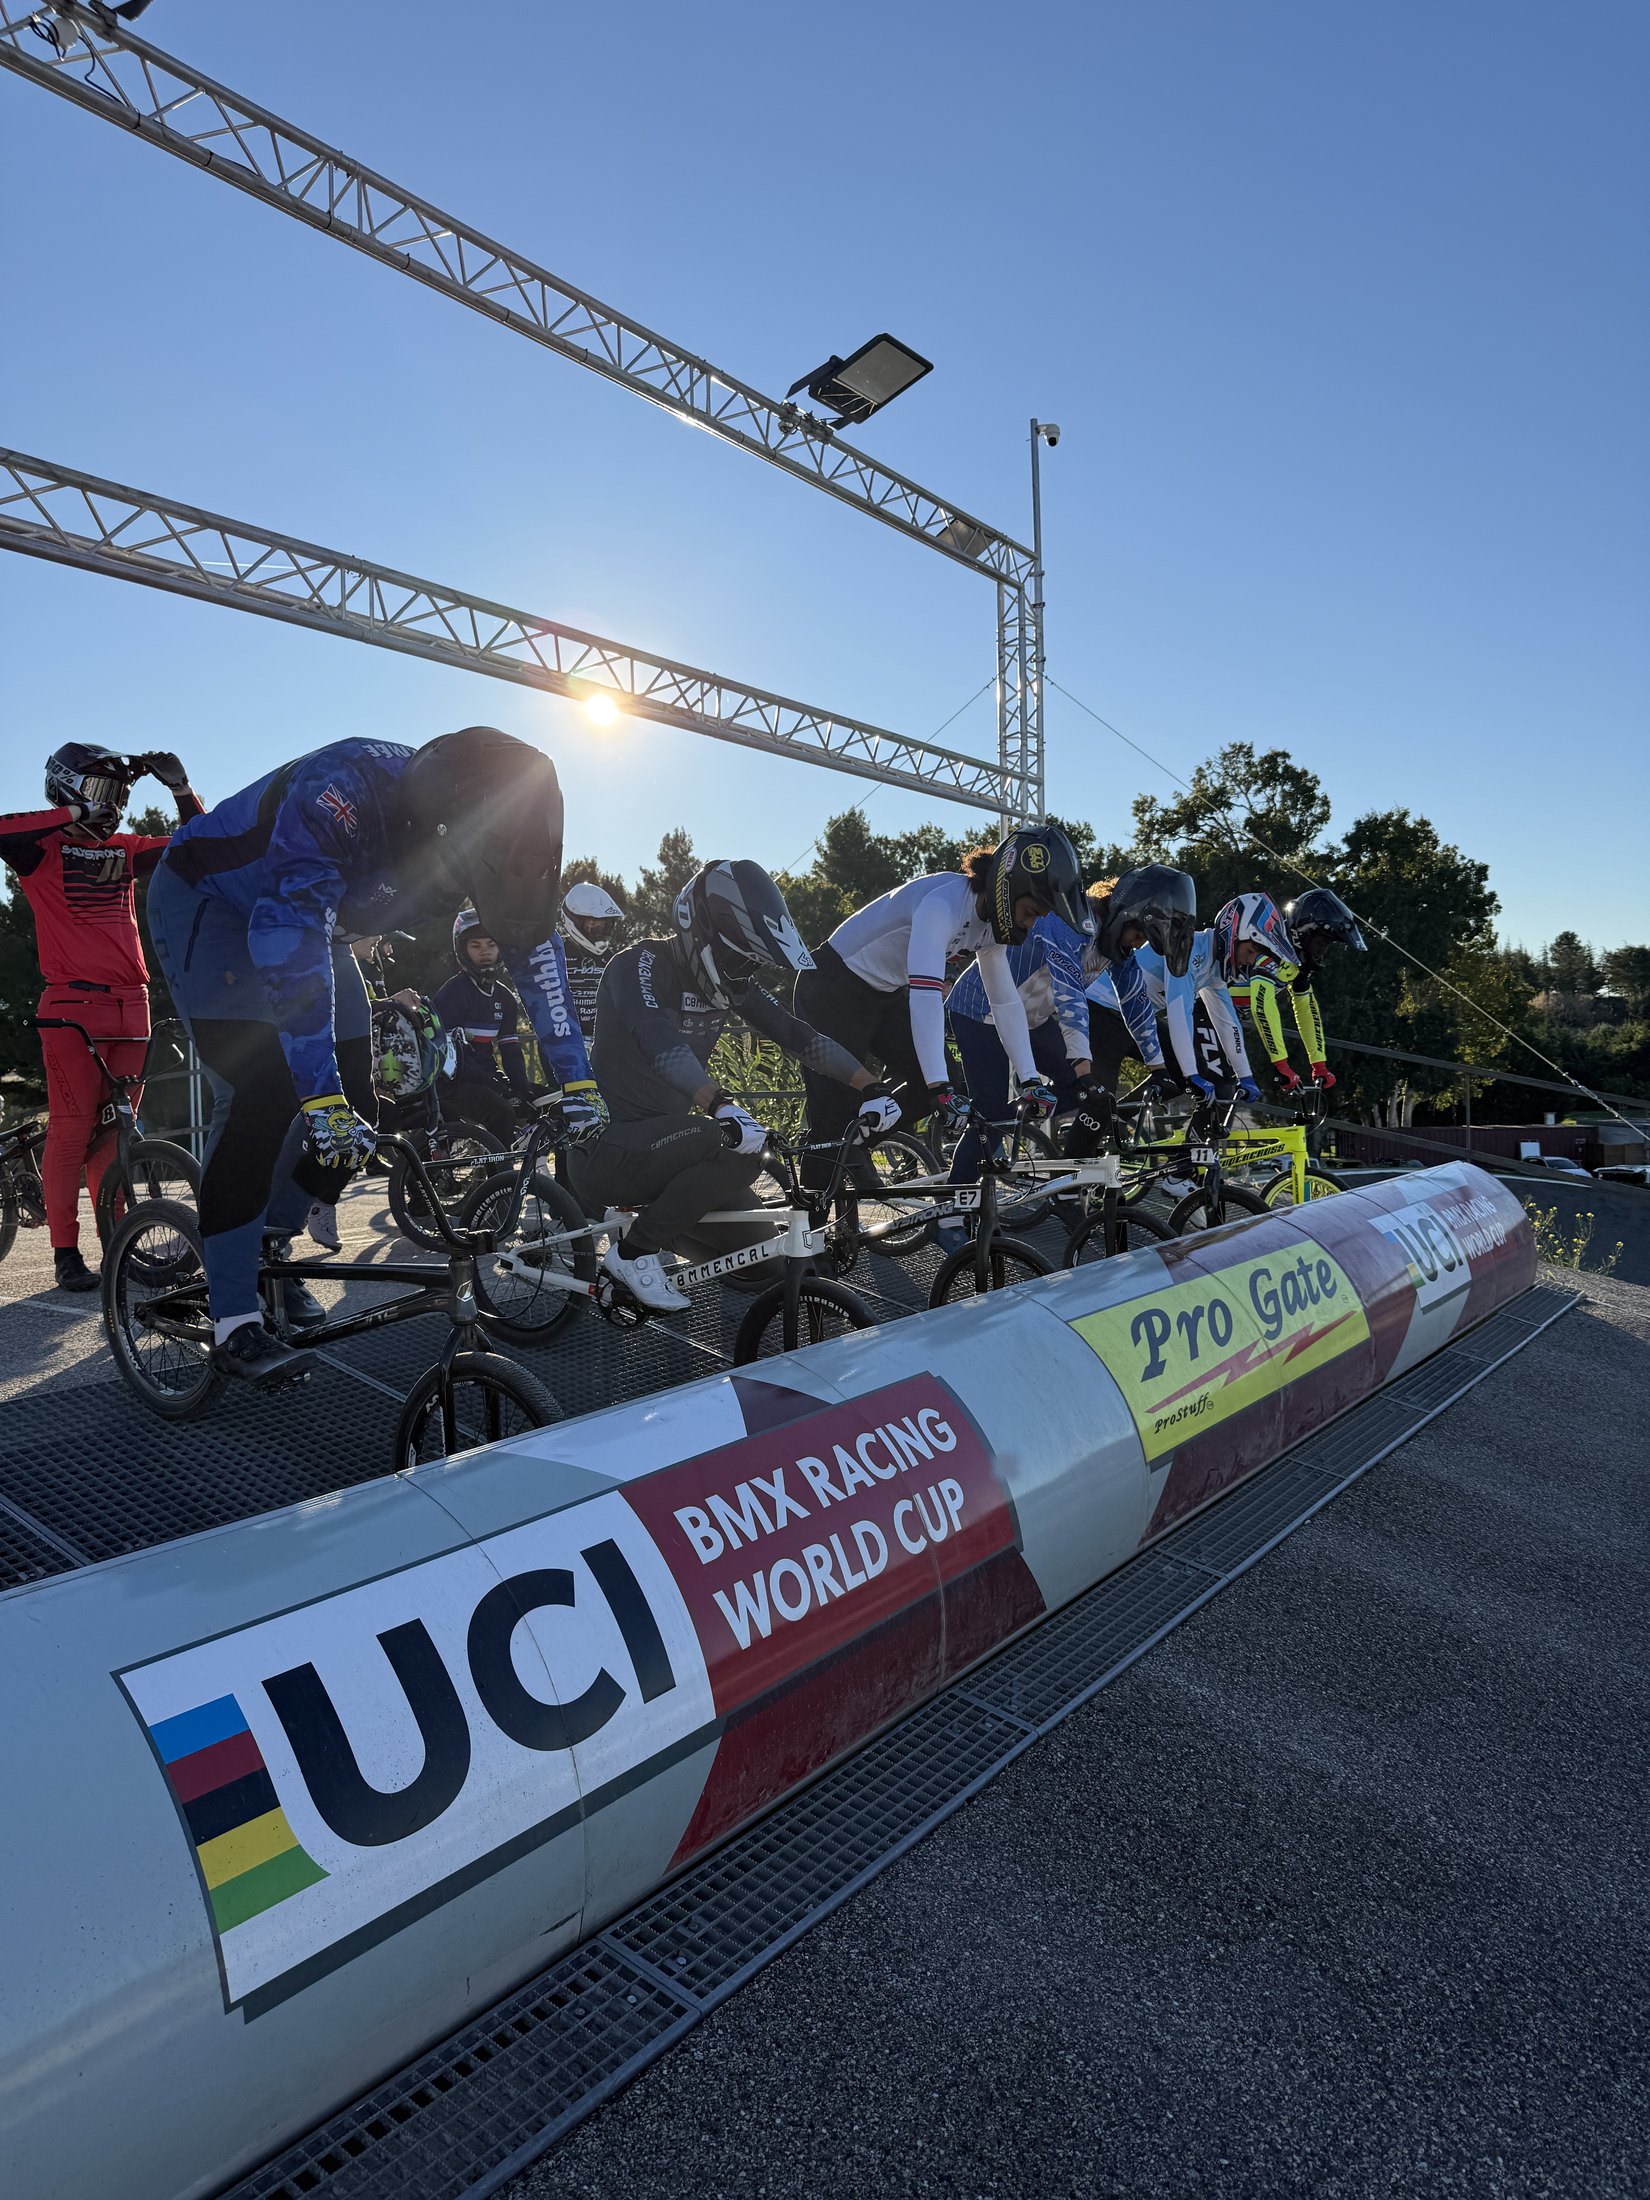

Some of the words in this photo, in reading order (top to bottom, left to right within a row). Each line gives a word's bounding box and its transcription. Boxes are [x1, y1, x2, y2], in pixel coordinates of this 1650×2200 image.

[566, 966, 605, 975] CHAS
[1196, 1027, 1224, 1078] FLY
[1232, 1026, 1242, 1054] PENKS
[959, 1190, 977, 1206] E7
[1393, 1214, 1463, 1282] UCI
[1462, 1227, 1492, 1260] WORLD
[1489, 1222, 1507, 1248] CUP
[676, 1245, 770, 1287] OMMENCAL
[1130, 1298, 1233, 1383] Pro
[1249, 1256, 1338, 1341] Gate
[1154, 1392, 1210, 1434] ProStuff
[673, 1467, 811, 1564] BMX
[796, 1407, 958, 1508] RACING
[713, 1519, 888, 1650] WORLD
[893, 1478, 965, 1555] CUP
[261, 1538, 677, 1847] UCI
